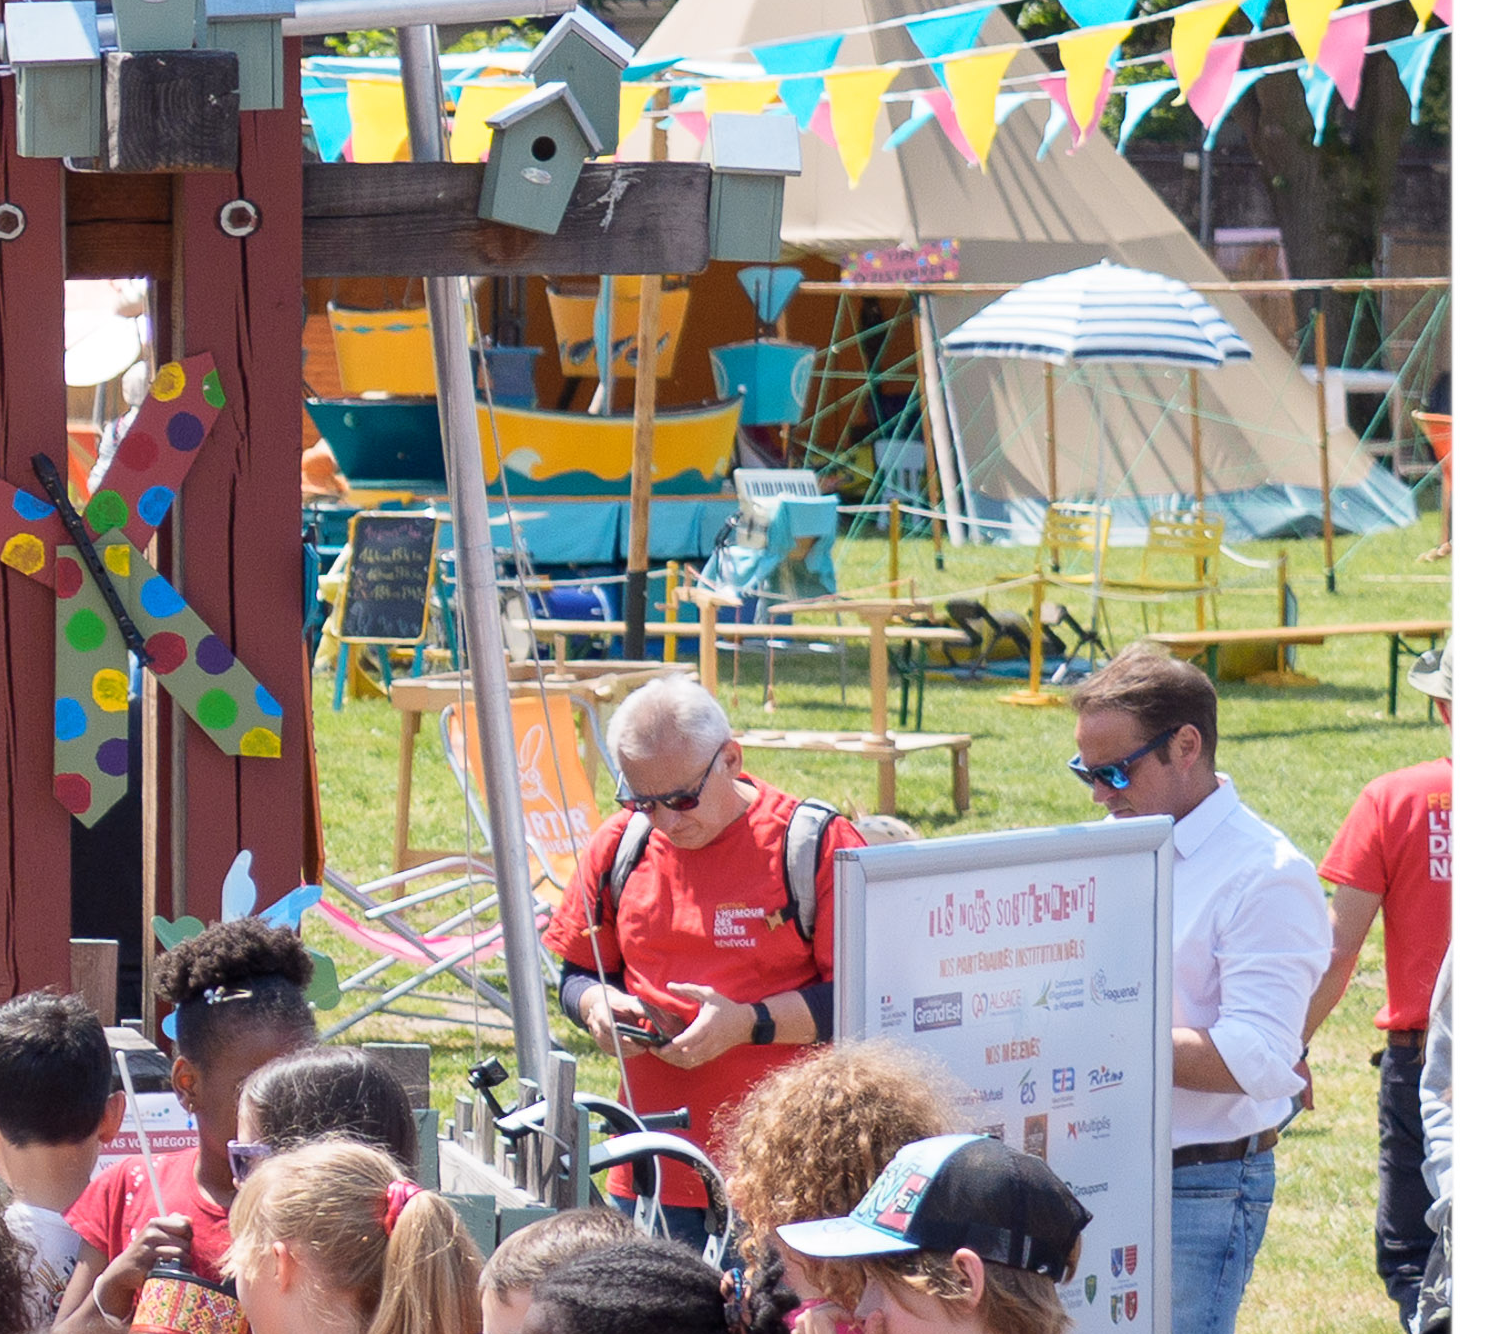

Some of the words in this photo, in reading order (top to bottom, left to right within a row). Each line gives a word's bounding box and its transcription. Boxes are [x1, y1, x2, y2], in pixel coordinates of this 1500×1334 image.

[929, 893, 954, 937] ILS
[959, 889, 991, 934] NOUS
[105, 1139, 125, 1148] AS
[153, 1136, 198, 1147] MÉGOTS
